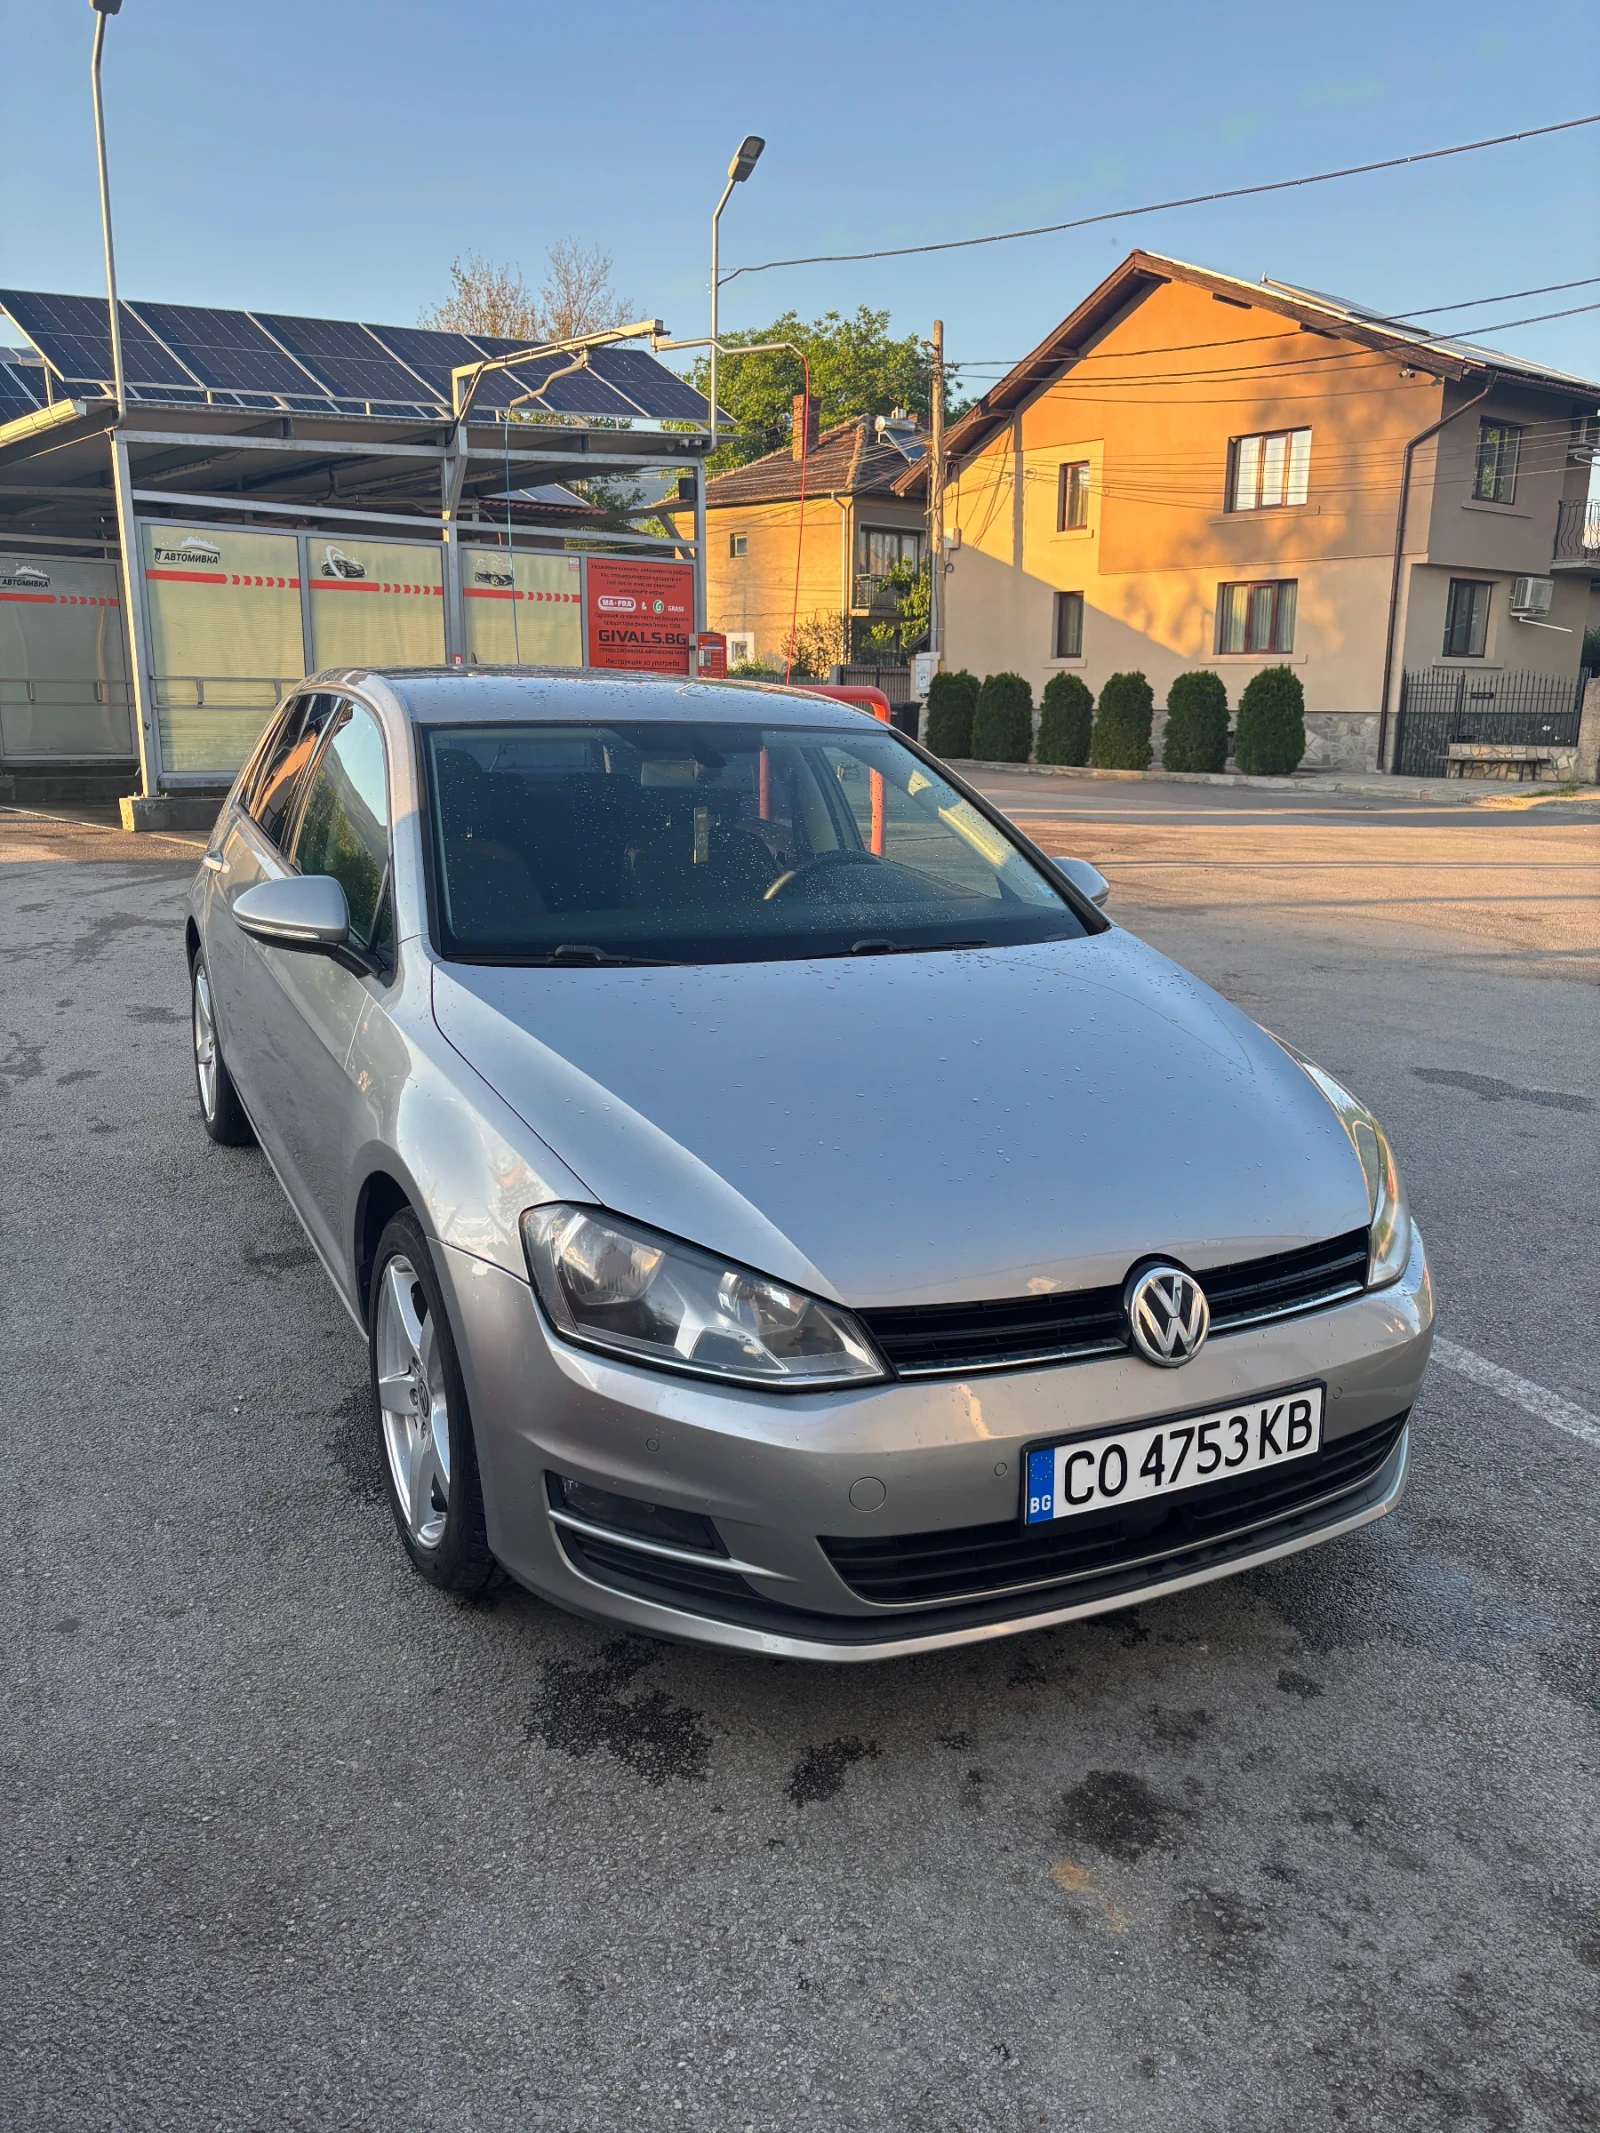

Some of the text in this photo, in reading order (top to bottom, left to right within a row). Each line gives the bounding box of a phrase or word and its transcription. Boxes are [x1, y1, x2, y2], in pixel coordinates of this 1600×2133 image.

[164, 553, 218, 564] АВТОМИВКА
[2, 578, 49, 588] АВТОМИВКА
[641, 602, 647, 611] &
[598, 630, 687, 645] GIVALS.BG
[1064, 1400, 1312, 1505] CO 4753 KB
[1030, 1495, 1051, 1513] BG
